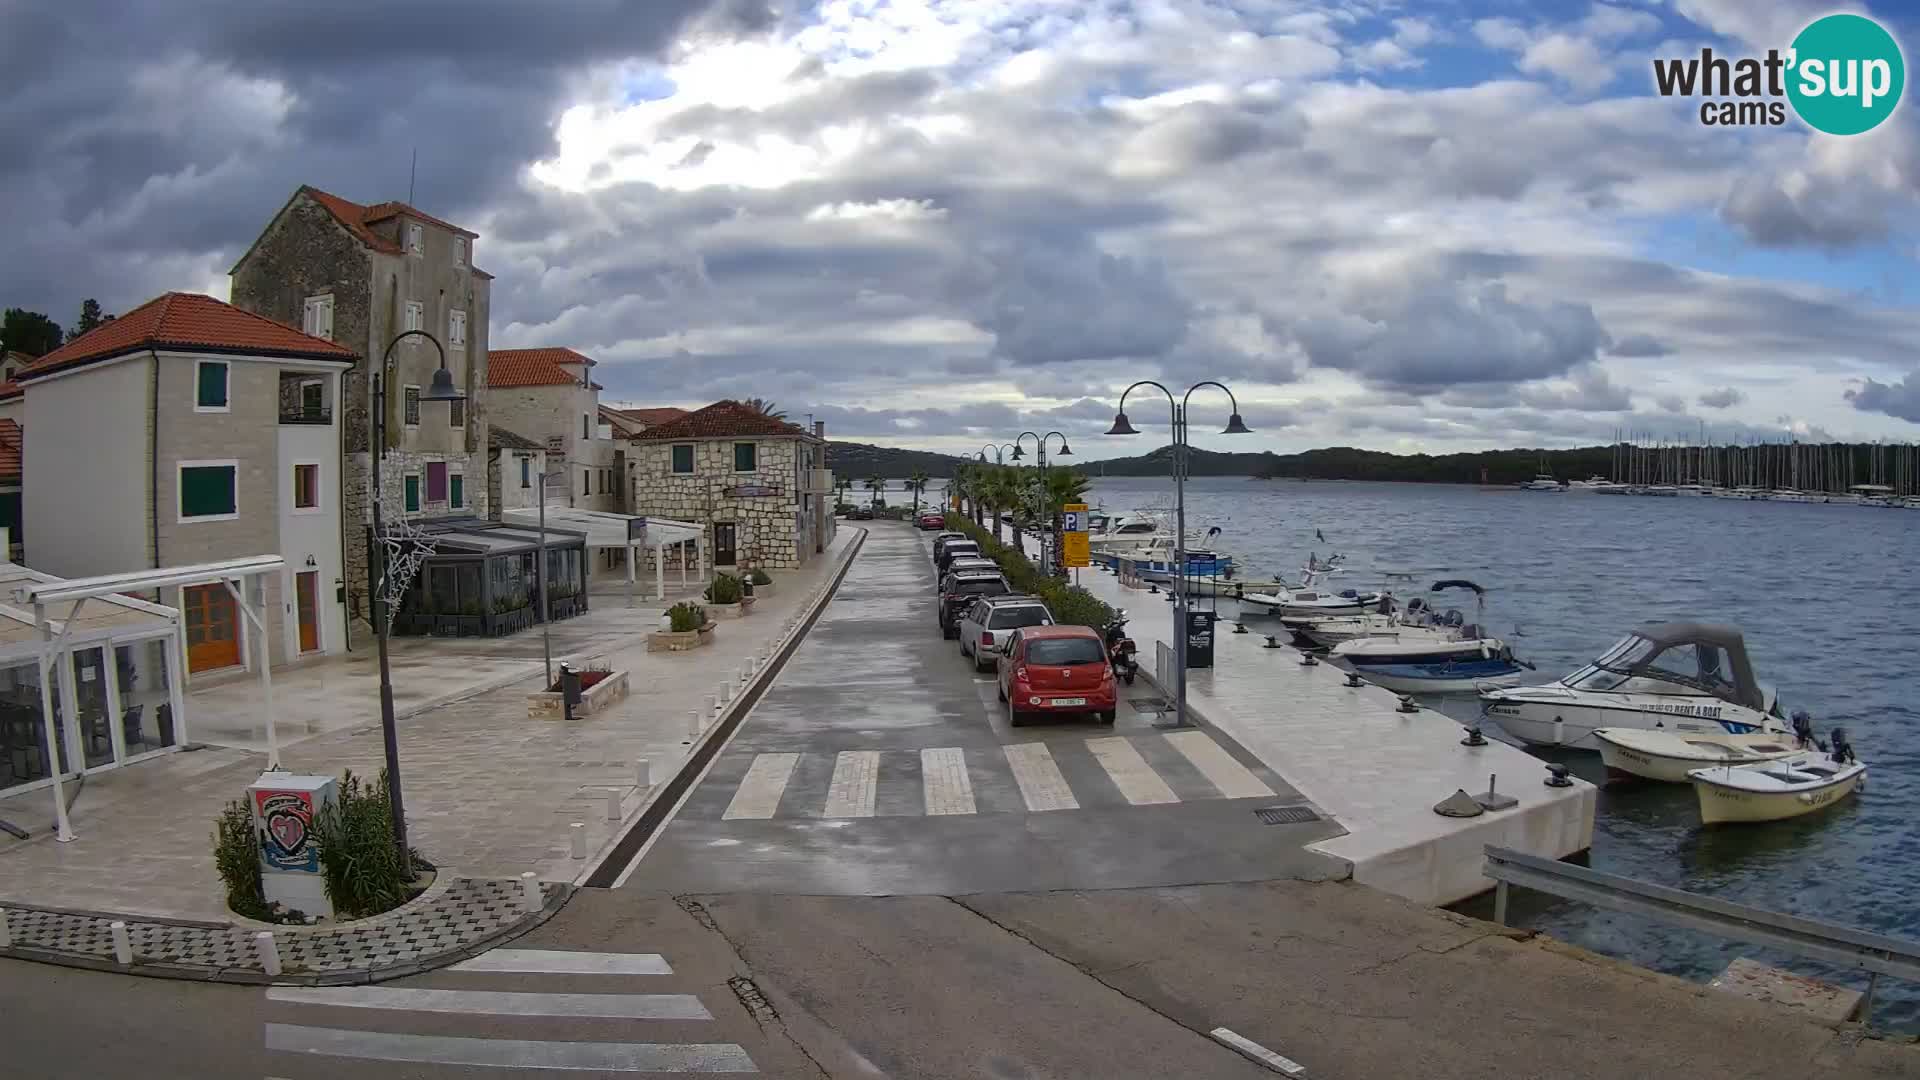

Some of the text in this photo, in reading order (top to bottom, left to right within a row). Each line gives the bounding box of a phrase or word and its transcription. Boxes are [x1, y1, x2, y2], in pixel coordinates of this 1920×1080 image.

[1065, 513, 1076, 529] P
[1674, 705, 1696, 715] RENT
[1702, 706, 1722, 718] BOAT
